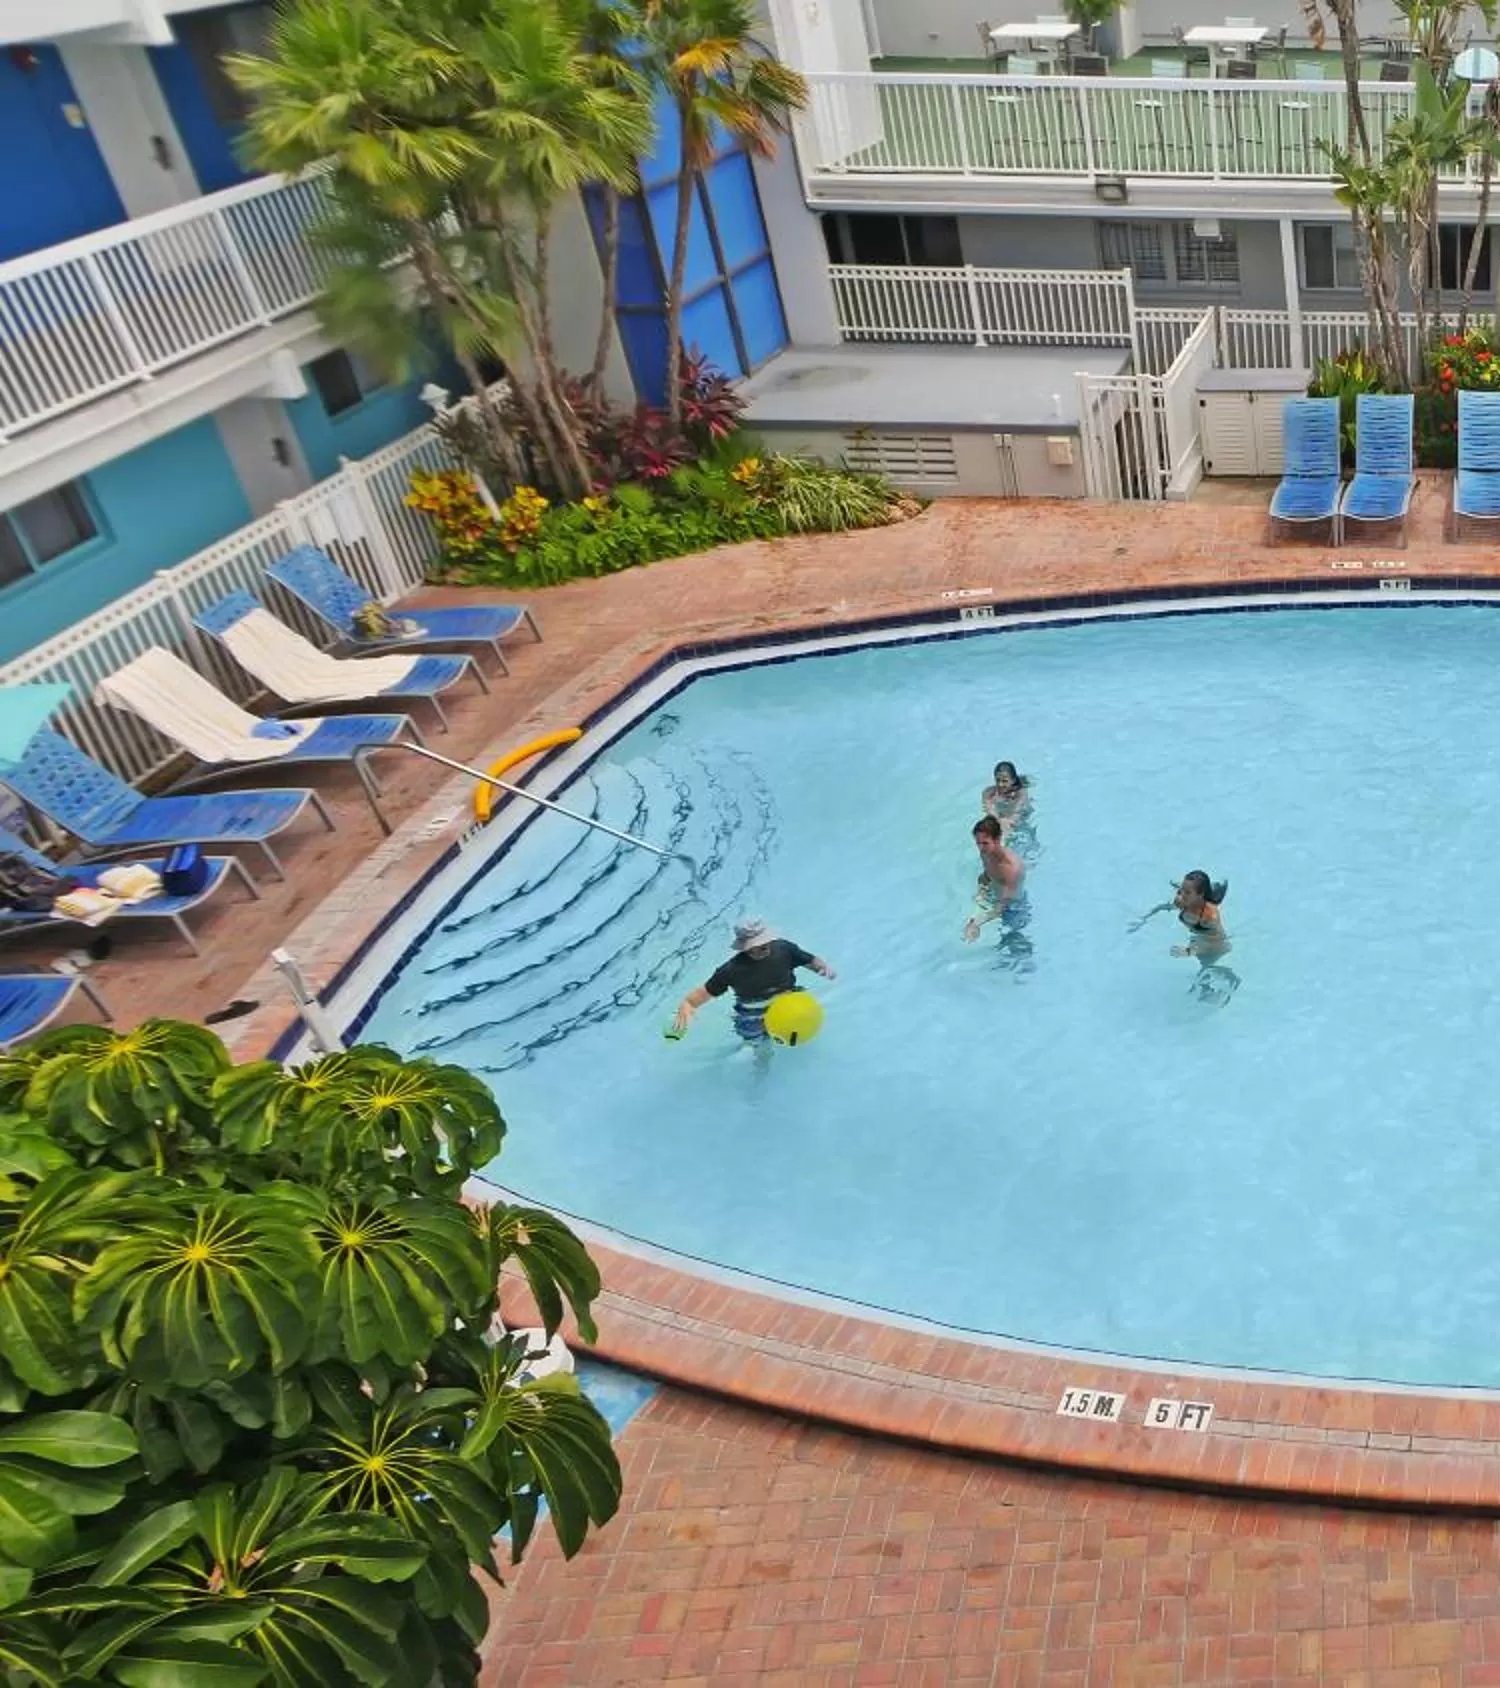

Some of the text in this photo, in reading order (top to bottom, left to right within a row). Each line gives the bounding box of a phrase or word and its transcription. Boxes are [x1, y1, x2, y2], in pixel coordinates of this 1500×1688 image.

[1063, 1392, 1116, 1417] 1.5 M.
[1155, 1403, 1211, 1429] 5 FT
